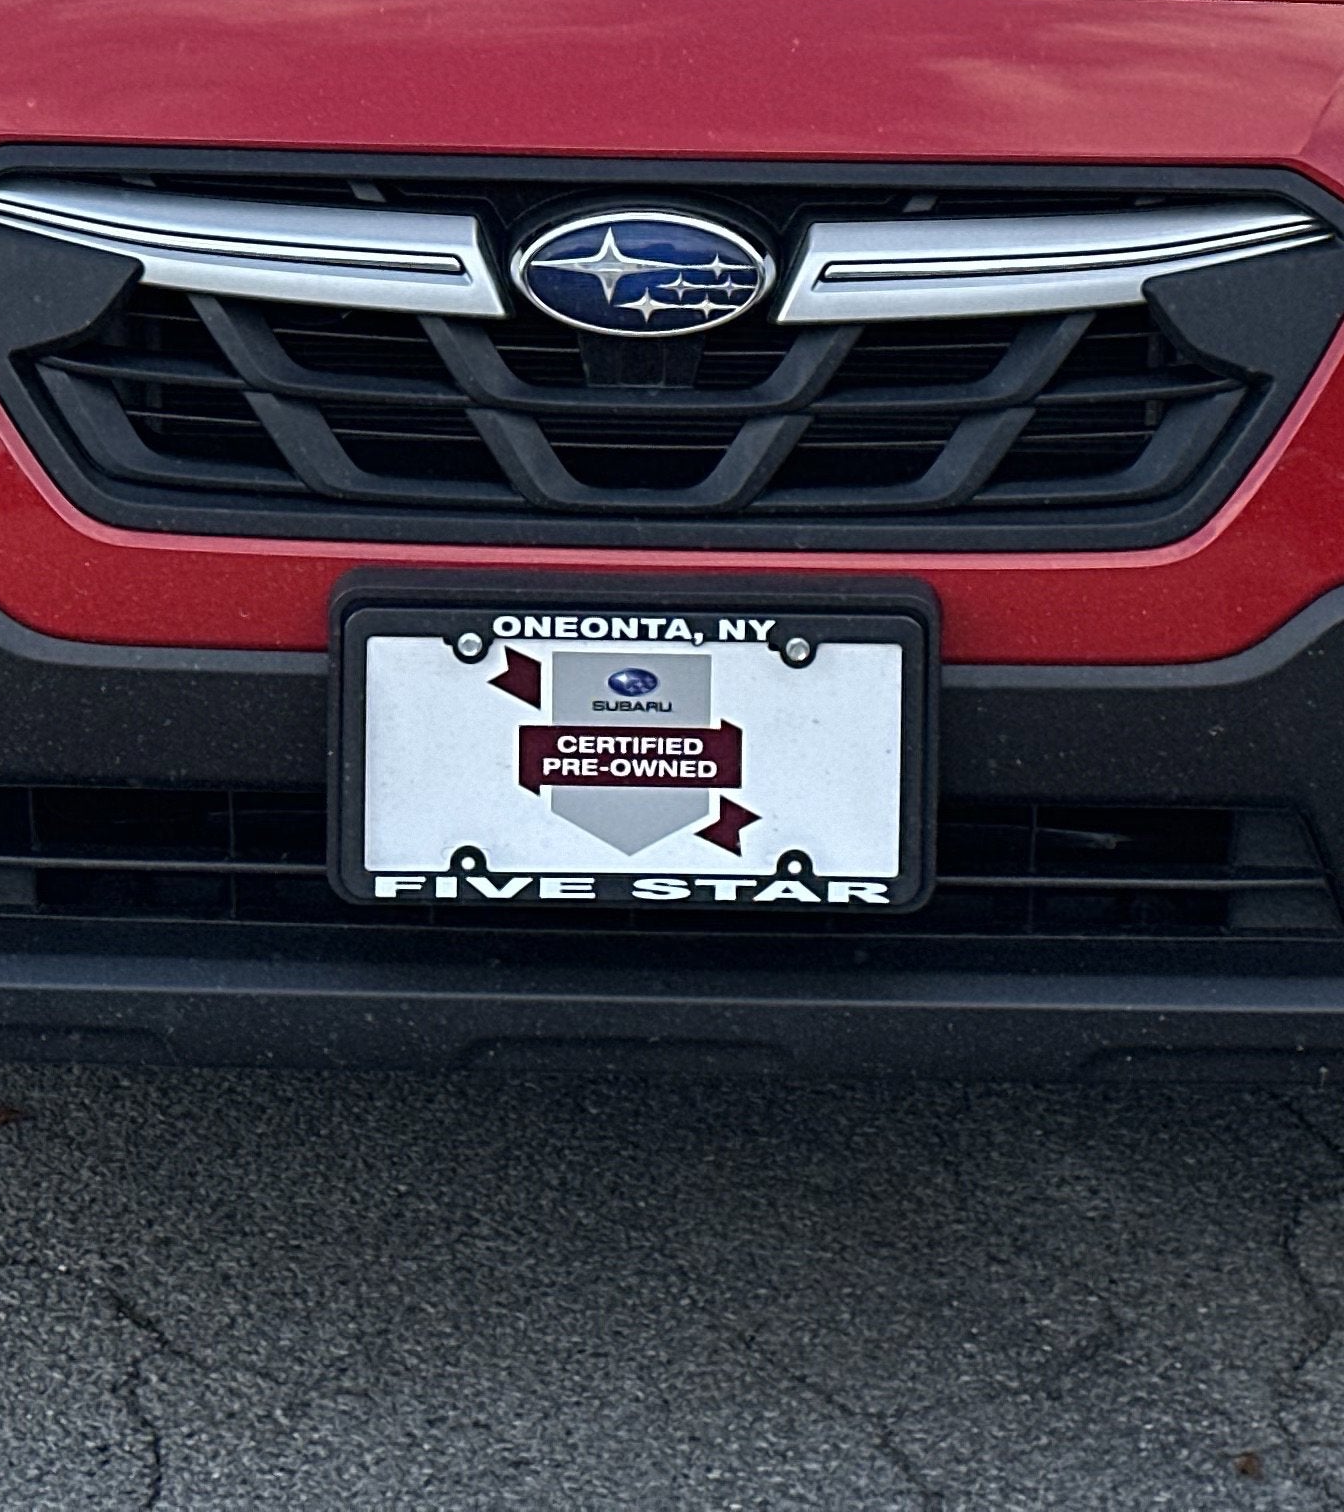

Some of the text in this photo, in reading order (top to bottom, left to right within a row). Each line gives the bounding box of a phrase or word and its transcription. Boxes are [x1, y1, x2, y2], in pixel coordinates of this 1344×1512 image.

[492, 616, 776, 645] ONEONTA, NY
[592, 700, 673, 713] SUBARU
[557, 735, 704, 756] CERTIFIED
[542, 757, 718, 778] PRE-OWNED
[374, 876, 890, 904] FIVE STAR
